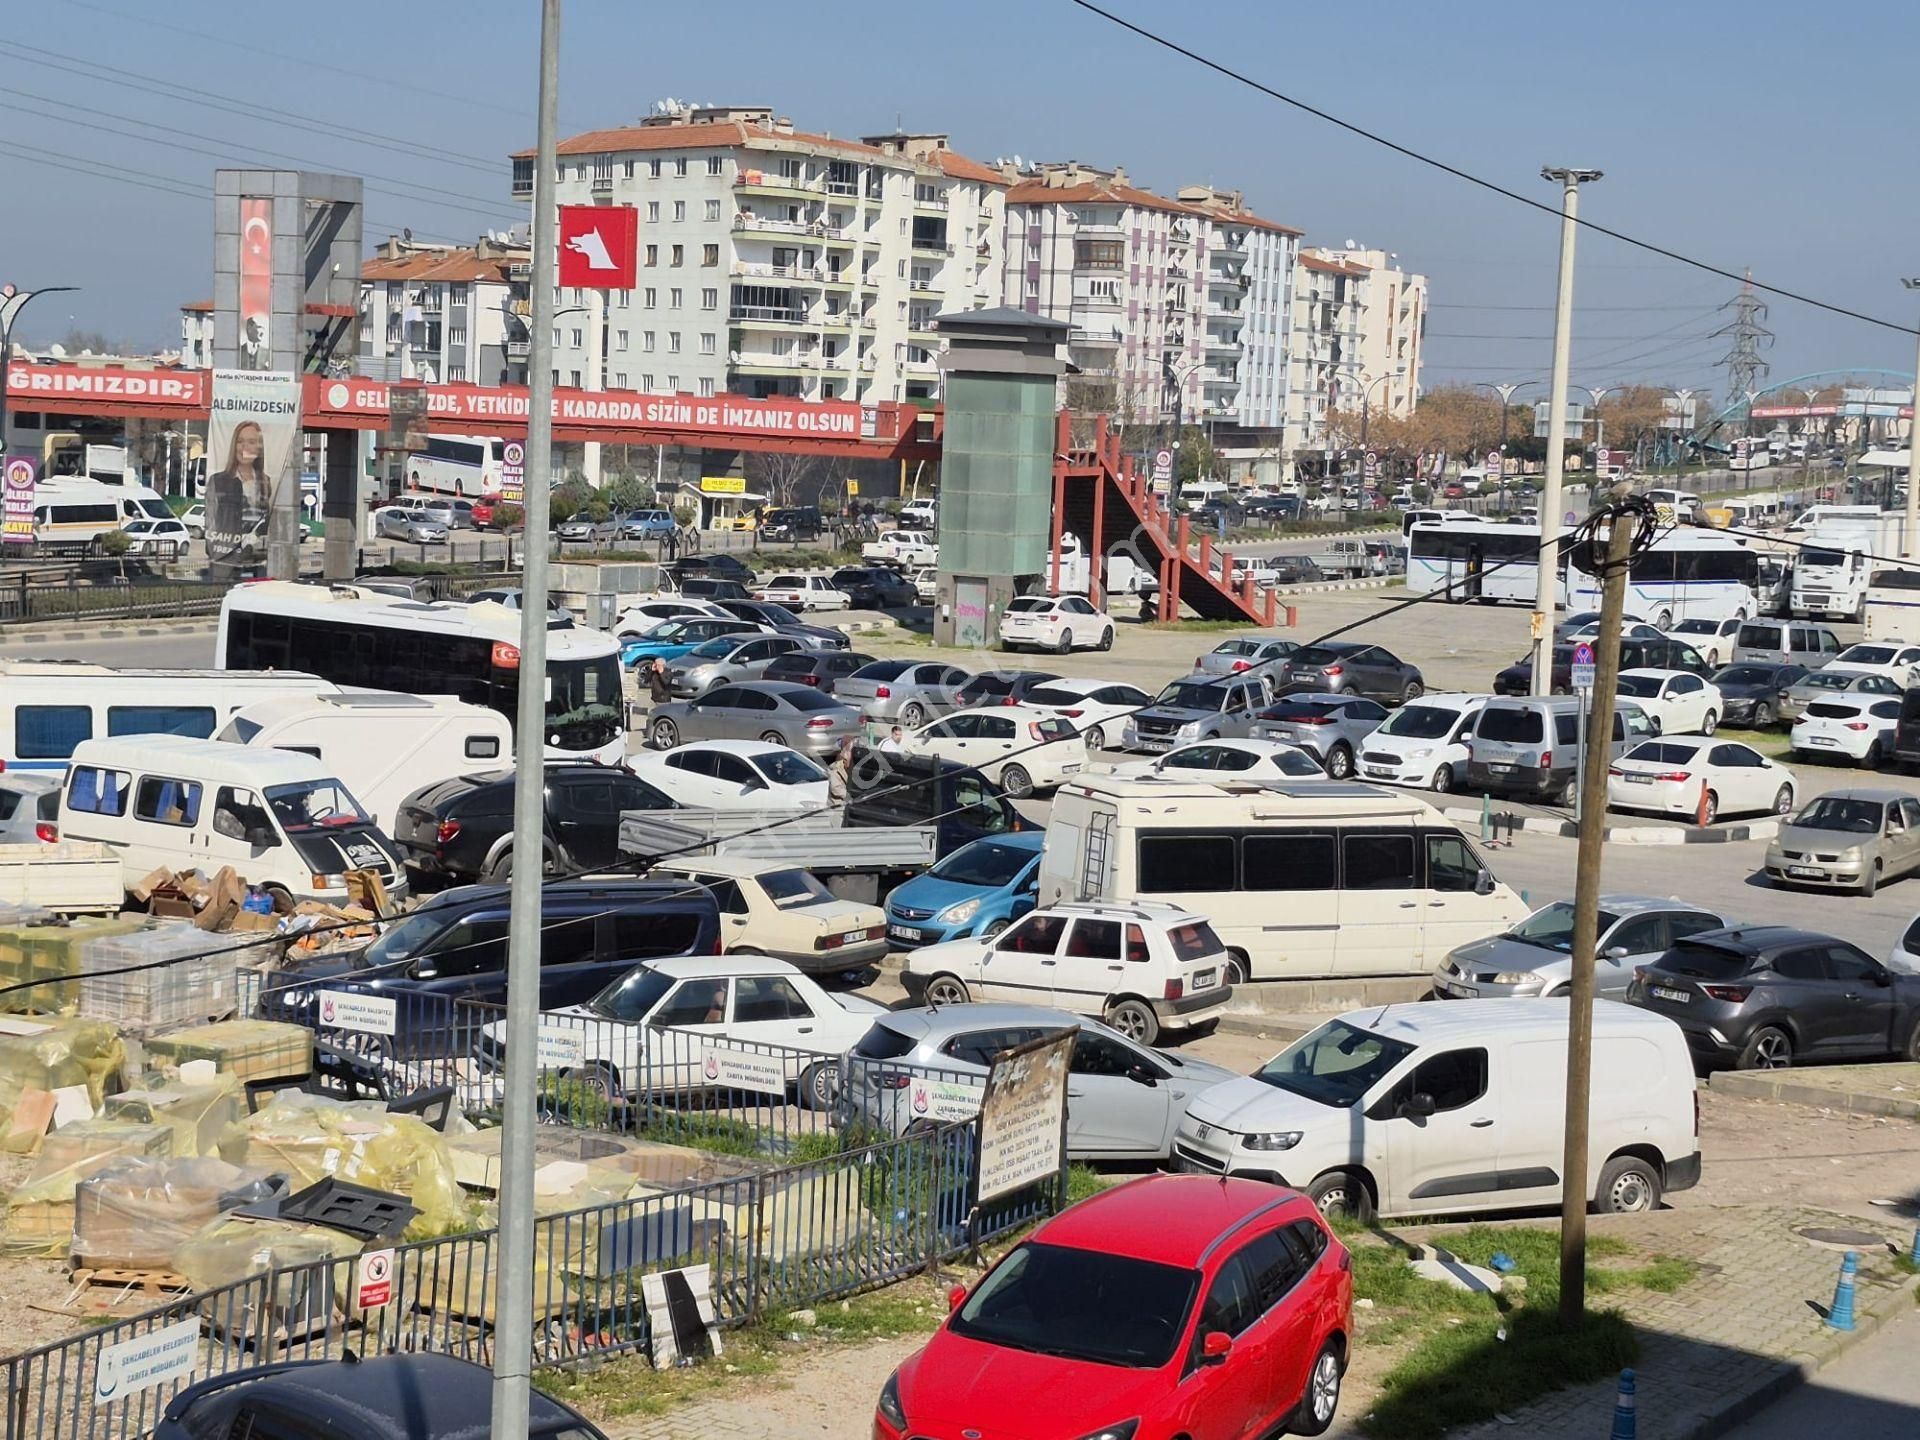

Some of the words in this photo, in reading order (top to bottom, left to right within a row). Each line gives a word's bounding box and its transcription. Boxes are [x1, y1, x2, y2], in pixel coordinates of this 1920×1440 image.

[7, 367, 195, 400] ĞRIMIZDIR;
[213, 395, 296, 413] ALBİMİZDESİN
[467, 392, 530, 416] YETKİD
[563, 400, 643, 421] KARARDA
[646, 400, 691, 424] SİZİN
[696, 406, 718, 425] DE
[723, 403, 793, 429] İMZANIZ
[797, 412, 855, 432] OLSUN
[205, 529, 232, 543] LŞAH
[126, 1369, 149, 1384] ZABITA
